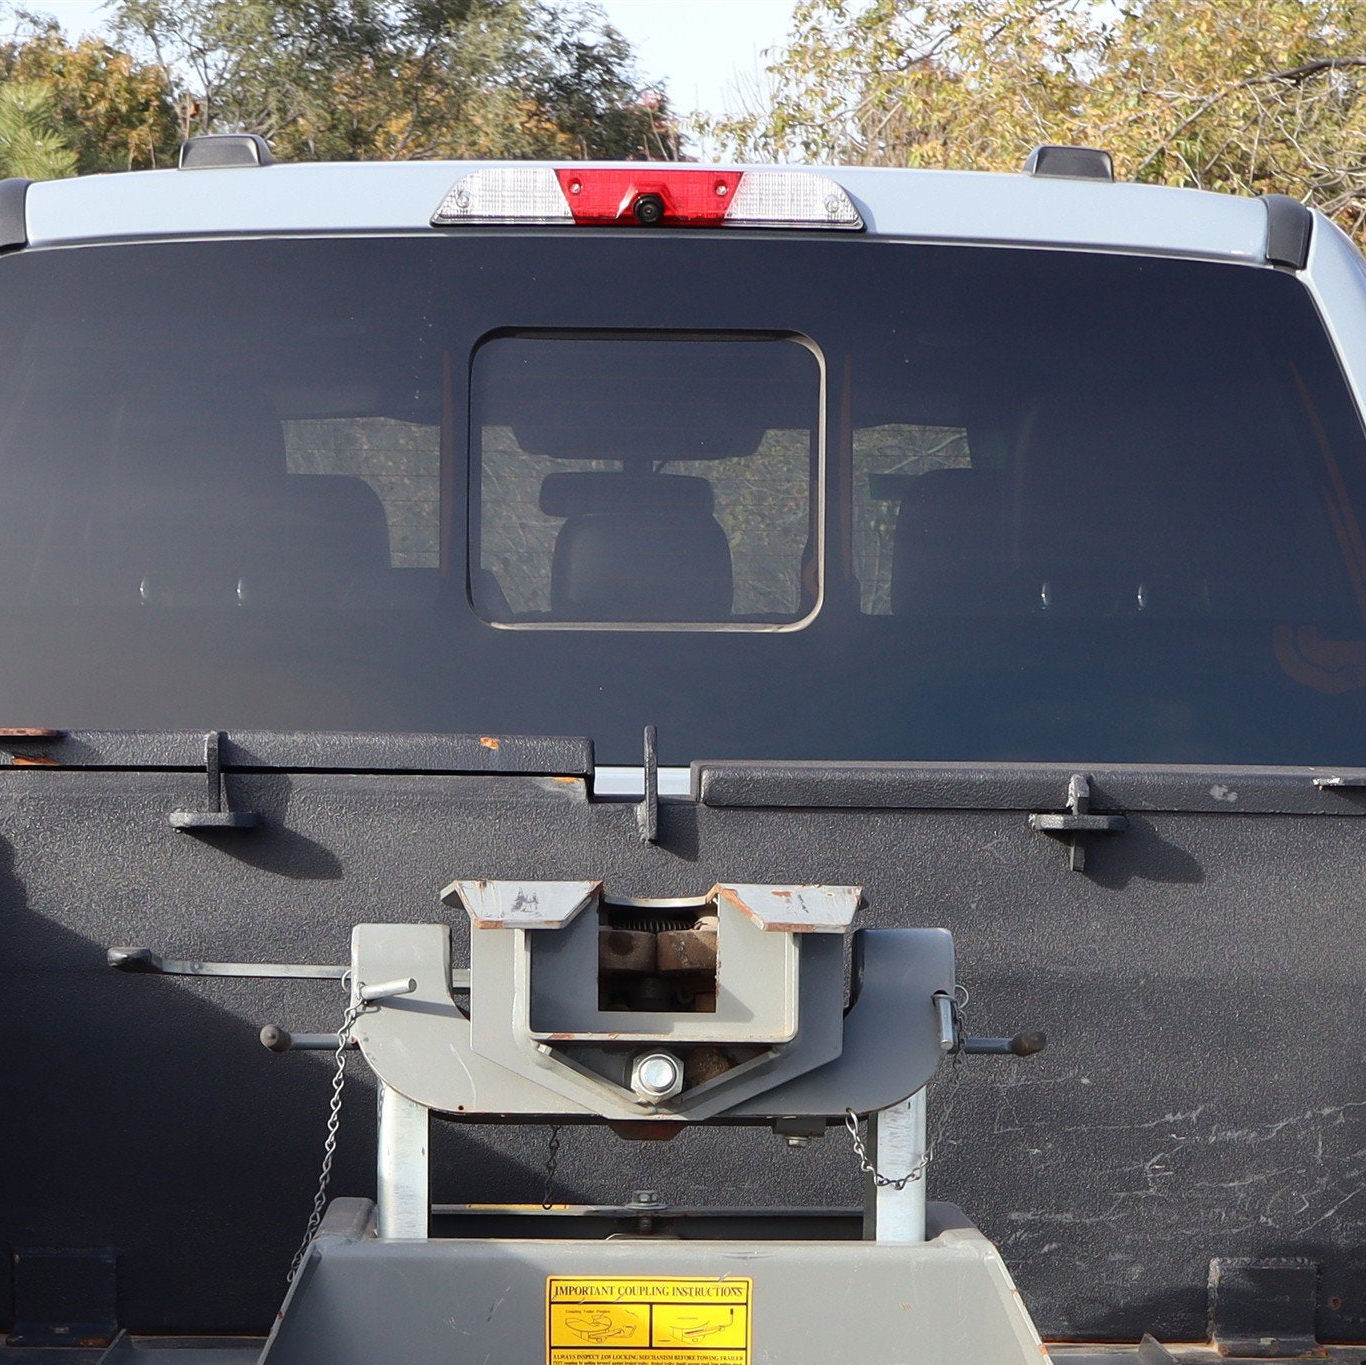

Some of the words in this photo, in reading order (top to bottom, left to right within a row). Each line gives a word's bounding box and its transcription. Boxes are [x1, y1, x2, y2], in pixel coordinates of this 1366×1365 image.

[555, 1286, 614, 1296] IMPORTANT
[618, 1286, 669, 1297] COUPLING
[672, 1287, 743, 1297] INSTRUCTIONS
